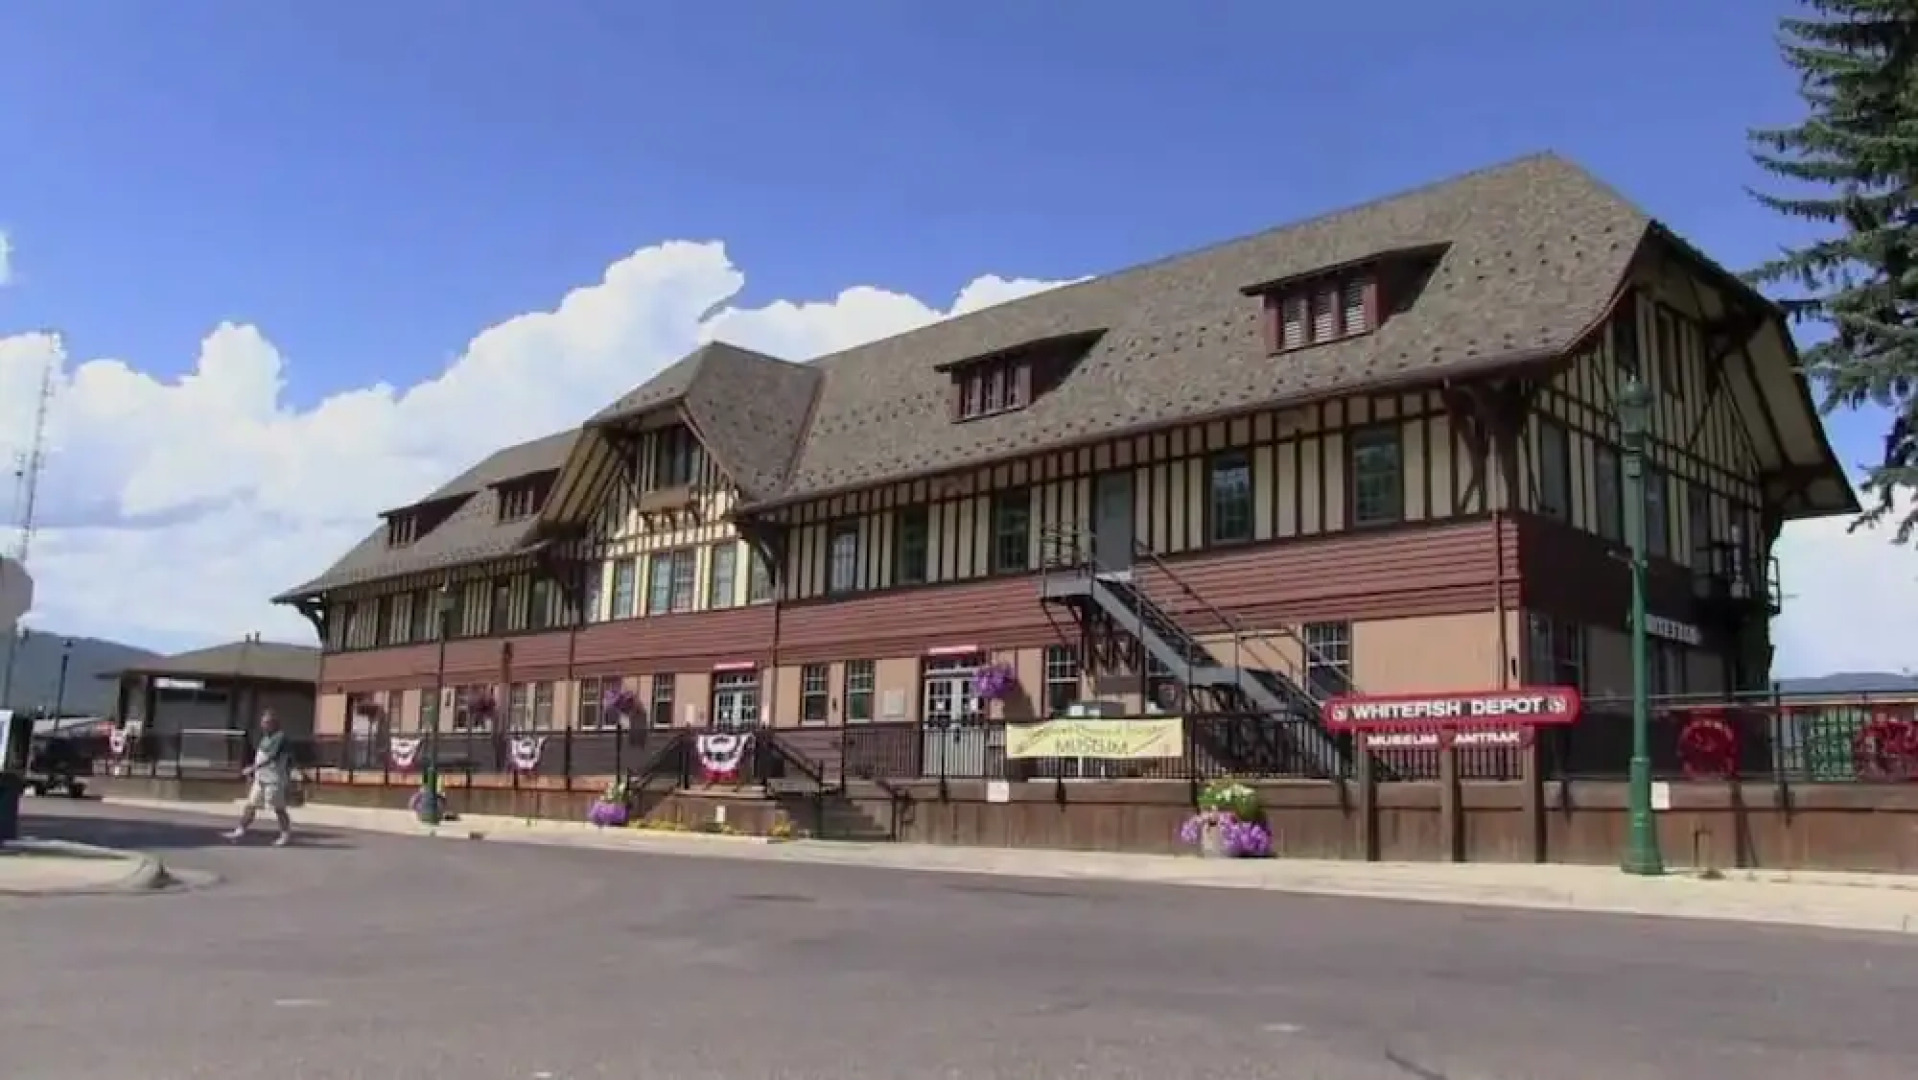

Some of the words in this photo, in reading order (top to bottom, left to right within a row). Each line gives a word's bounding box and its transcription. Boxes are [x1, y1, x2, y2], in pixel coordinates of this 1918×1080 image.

[1352, 698, 1461, 720] WHITEFISH
[1470, 696, 1544, 716] DEPOT
[1366, 733, 1438, 746] MUSEUM
[1453, 731, 1520, 745] AMTRAK
